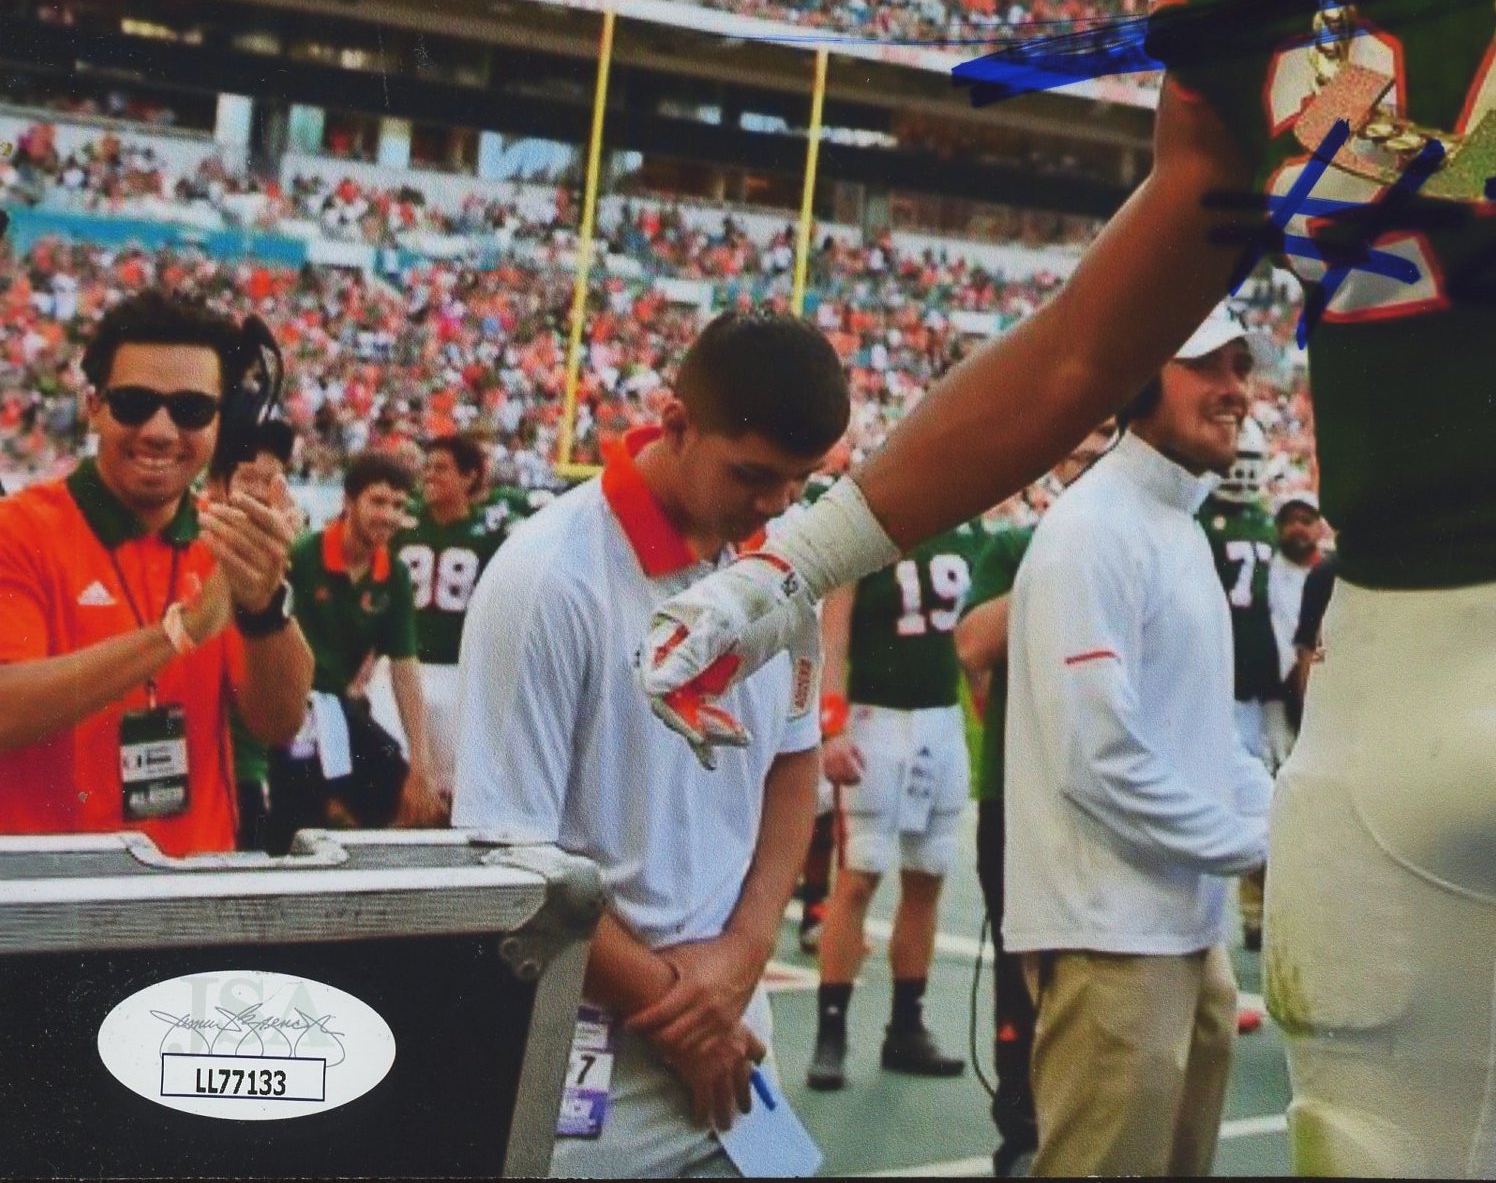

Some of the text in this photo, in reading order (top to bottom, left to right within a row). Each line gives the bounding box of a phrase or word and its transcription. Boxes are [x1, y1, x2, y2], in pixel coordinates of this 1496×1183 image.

[896, 553, 971, 636] 19
[195, 1067, 286, 1096] LL77133
[577, 1053, 597, 1084] 7
